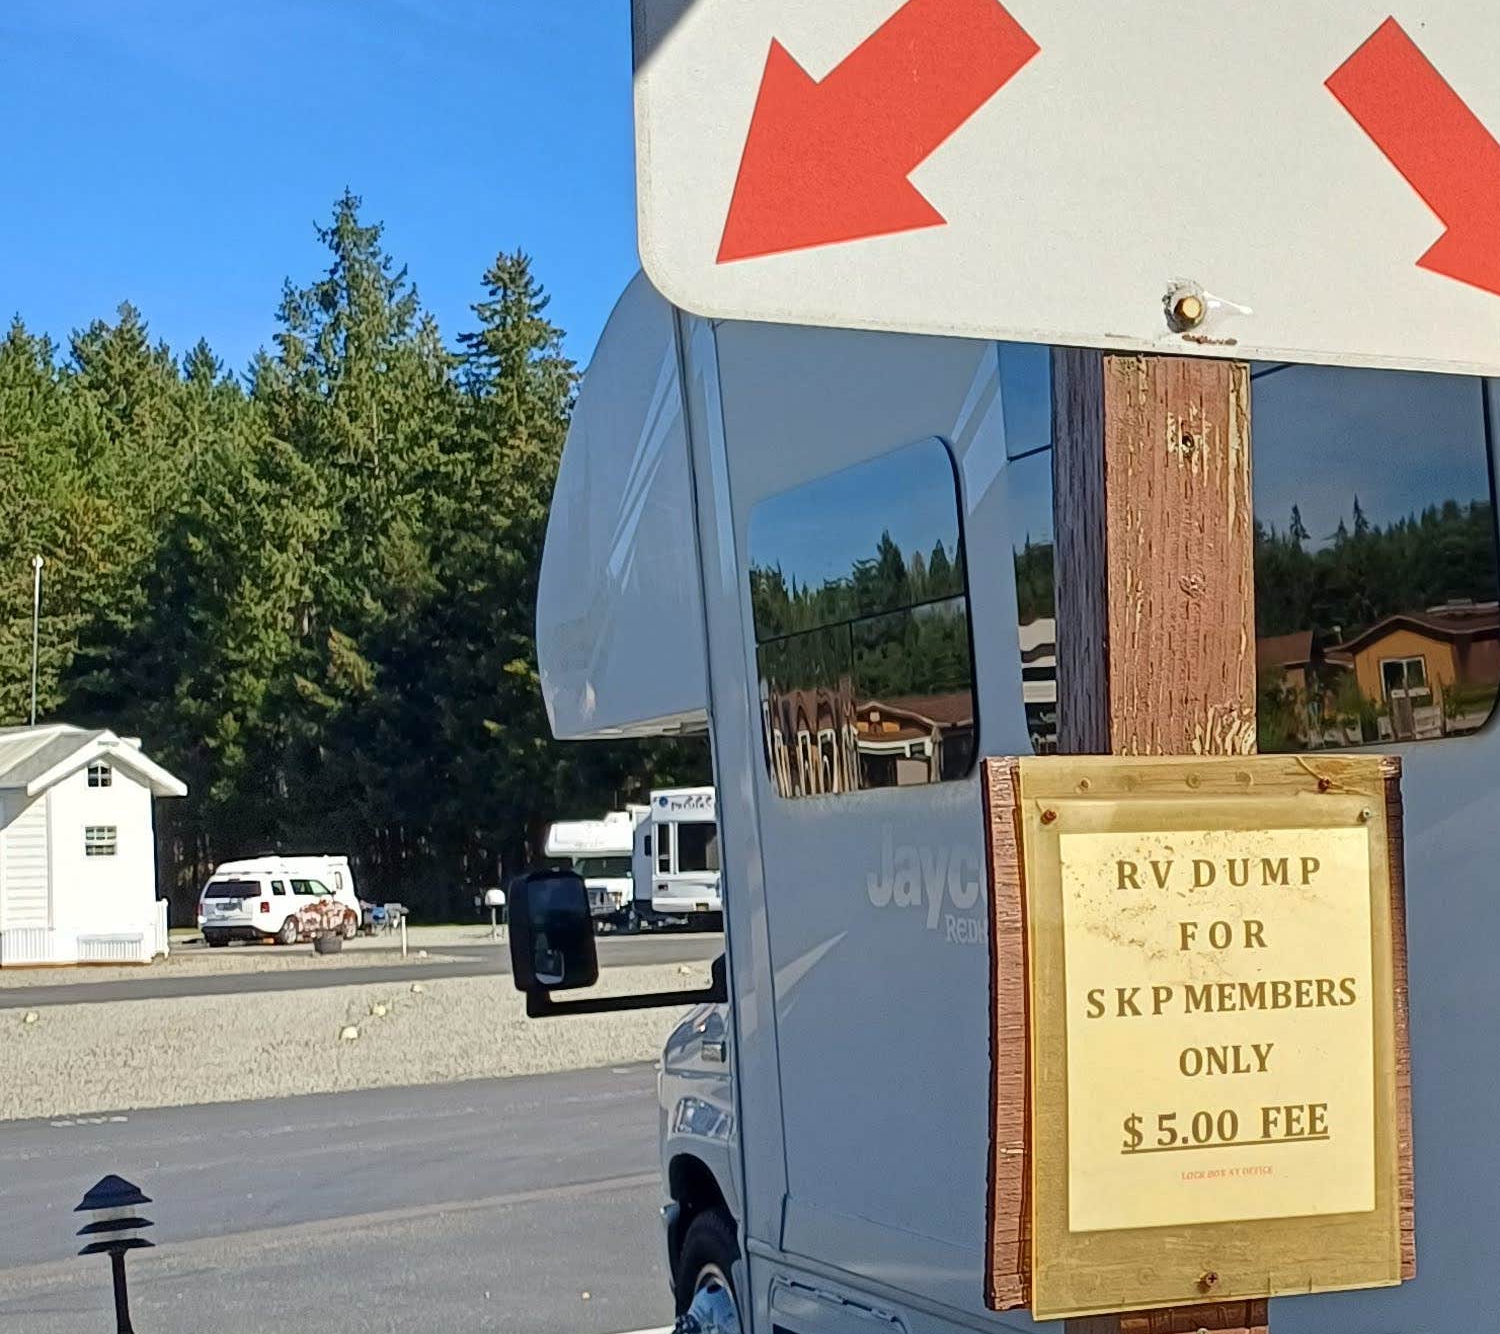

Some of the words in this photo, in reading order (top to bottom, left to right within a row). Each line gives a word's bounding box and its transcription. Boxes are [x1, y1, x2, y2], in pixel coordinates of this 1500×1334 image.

[866, 823, 988, 930] Jayc
[1192, 857, 1320, 888] DUMP
[1179, 919, 1268, 951] FOR
[1184, 977, 1356, 1014] MEMBERS
[1179, 1043, 1274, 1077] ONLY
[1260, 1103, 1329, 1140] FEE
